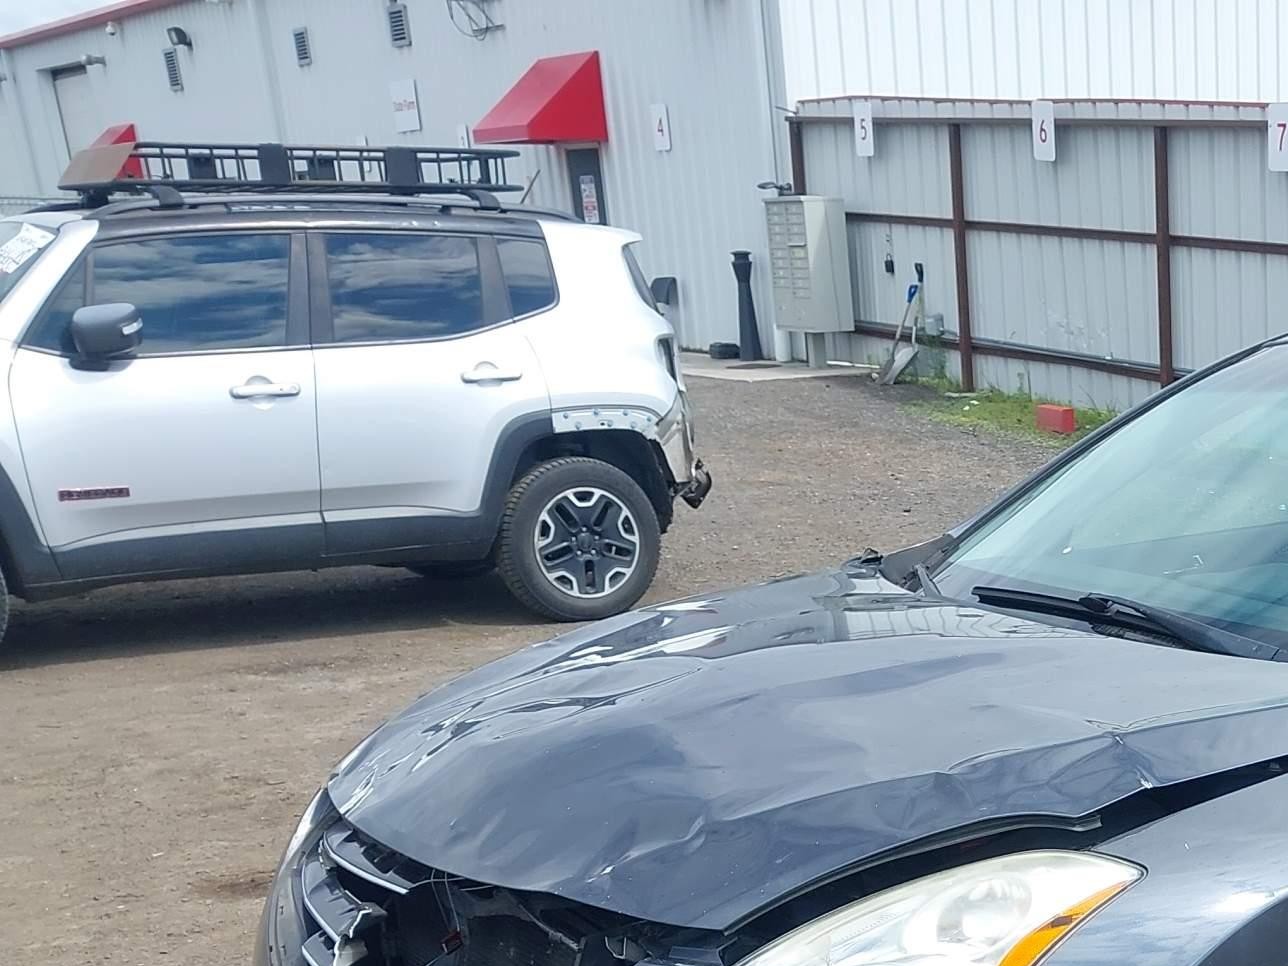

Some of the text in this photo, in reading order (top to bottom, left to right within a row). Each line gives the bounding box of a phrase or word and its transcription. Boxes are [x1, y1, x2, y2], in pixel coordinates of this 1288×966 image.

[657, 117, 664, 136] 4
[860, 118, 868, 140] 5
[1039, 119, 1048, 143] 6
[1276, 123, 1288, 151] 7
